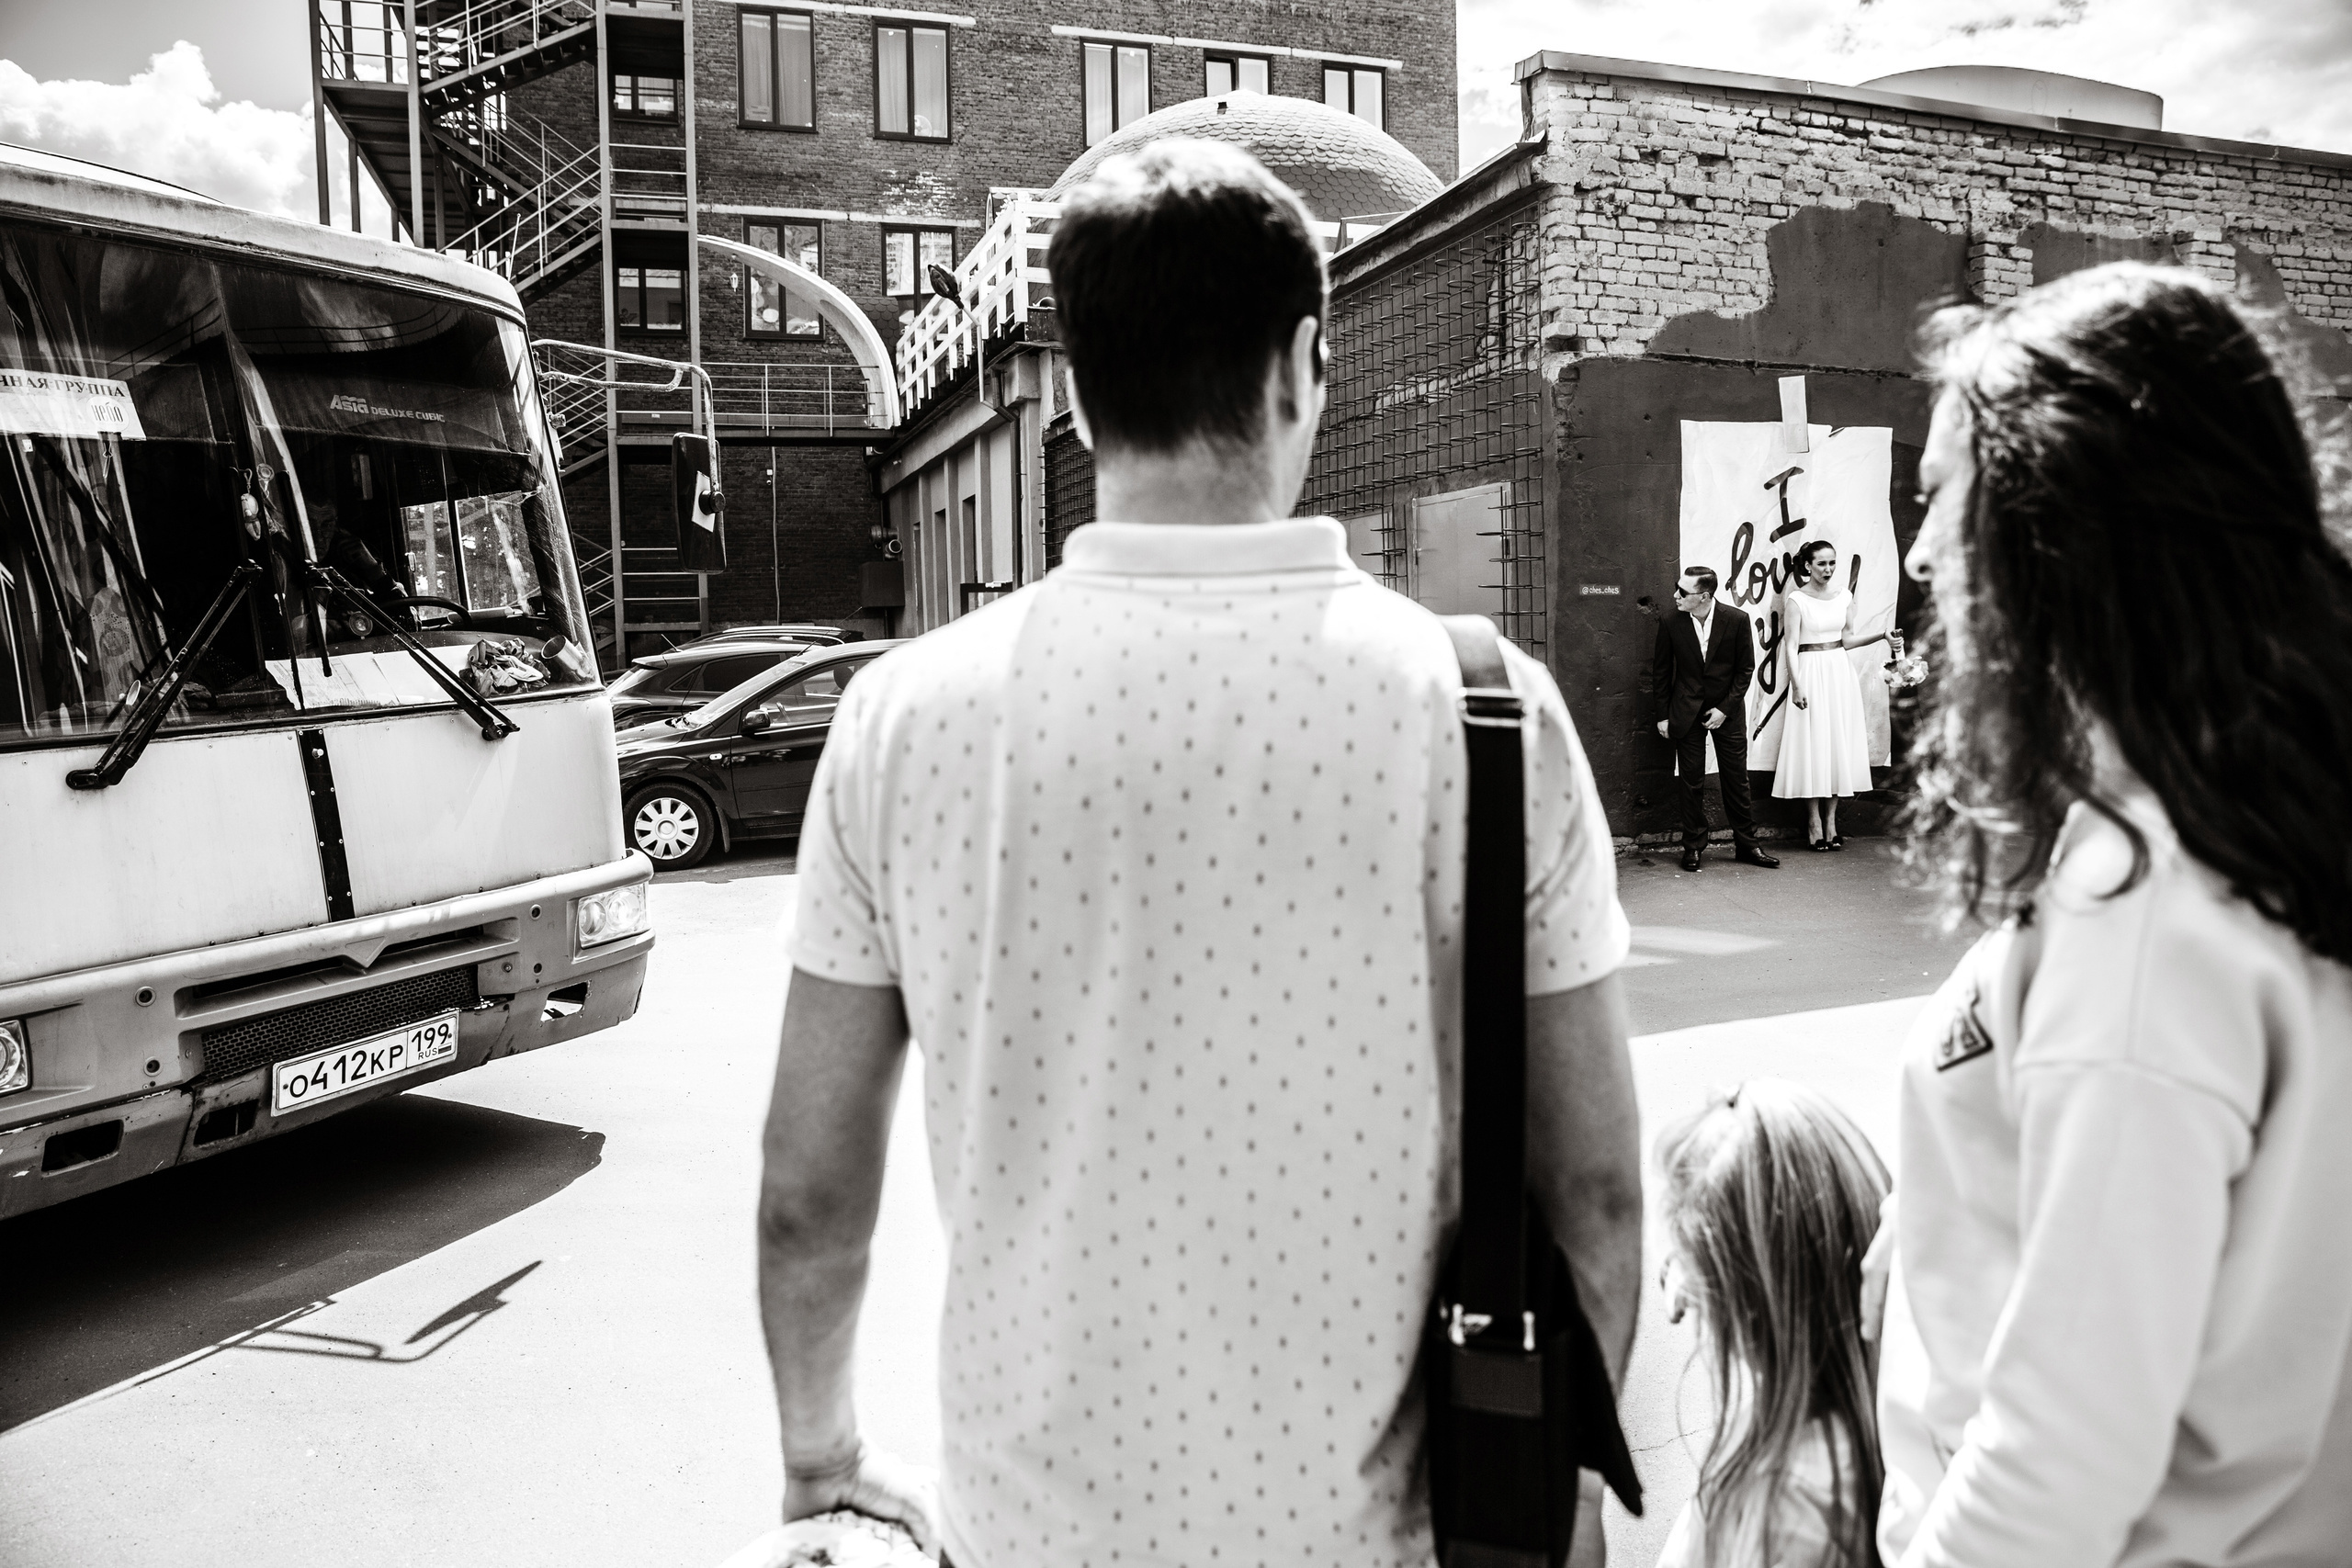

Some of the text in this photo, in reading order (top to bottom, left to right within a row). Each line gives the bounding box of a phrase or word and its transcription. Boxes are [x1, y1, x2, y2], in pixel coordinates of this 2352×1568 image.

[54, 379, 126, 398] ГРУППА
[91, 401, 124, 423] небо
[330, 394, 446, 423] Asia DELUXE CUBIC
[1764, 466, 1807, 544] I
[411, 1022, 450, 1054] 199
[417, 1048, 438, 1061] RUS
